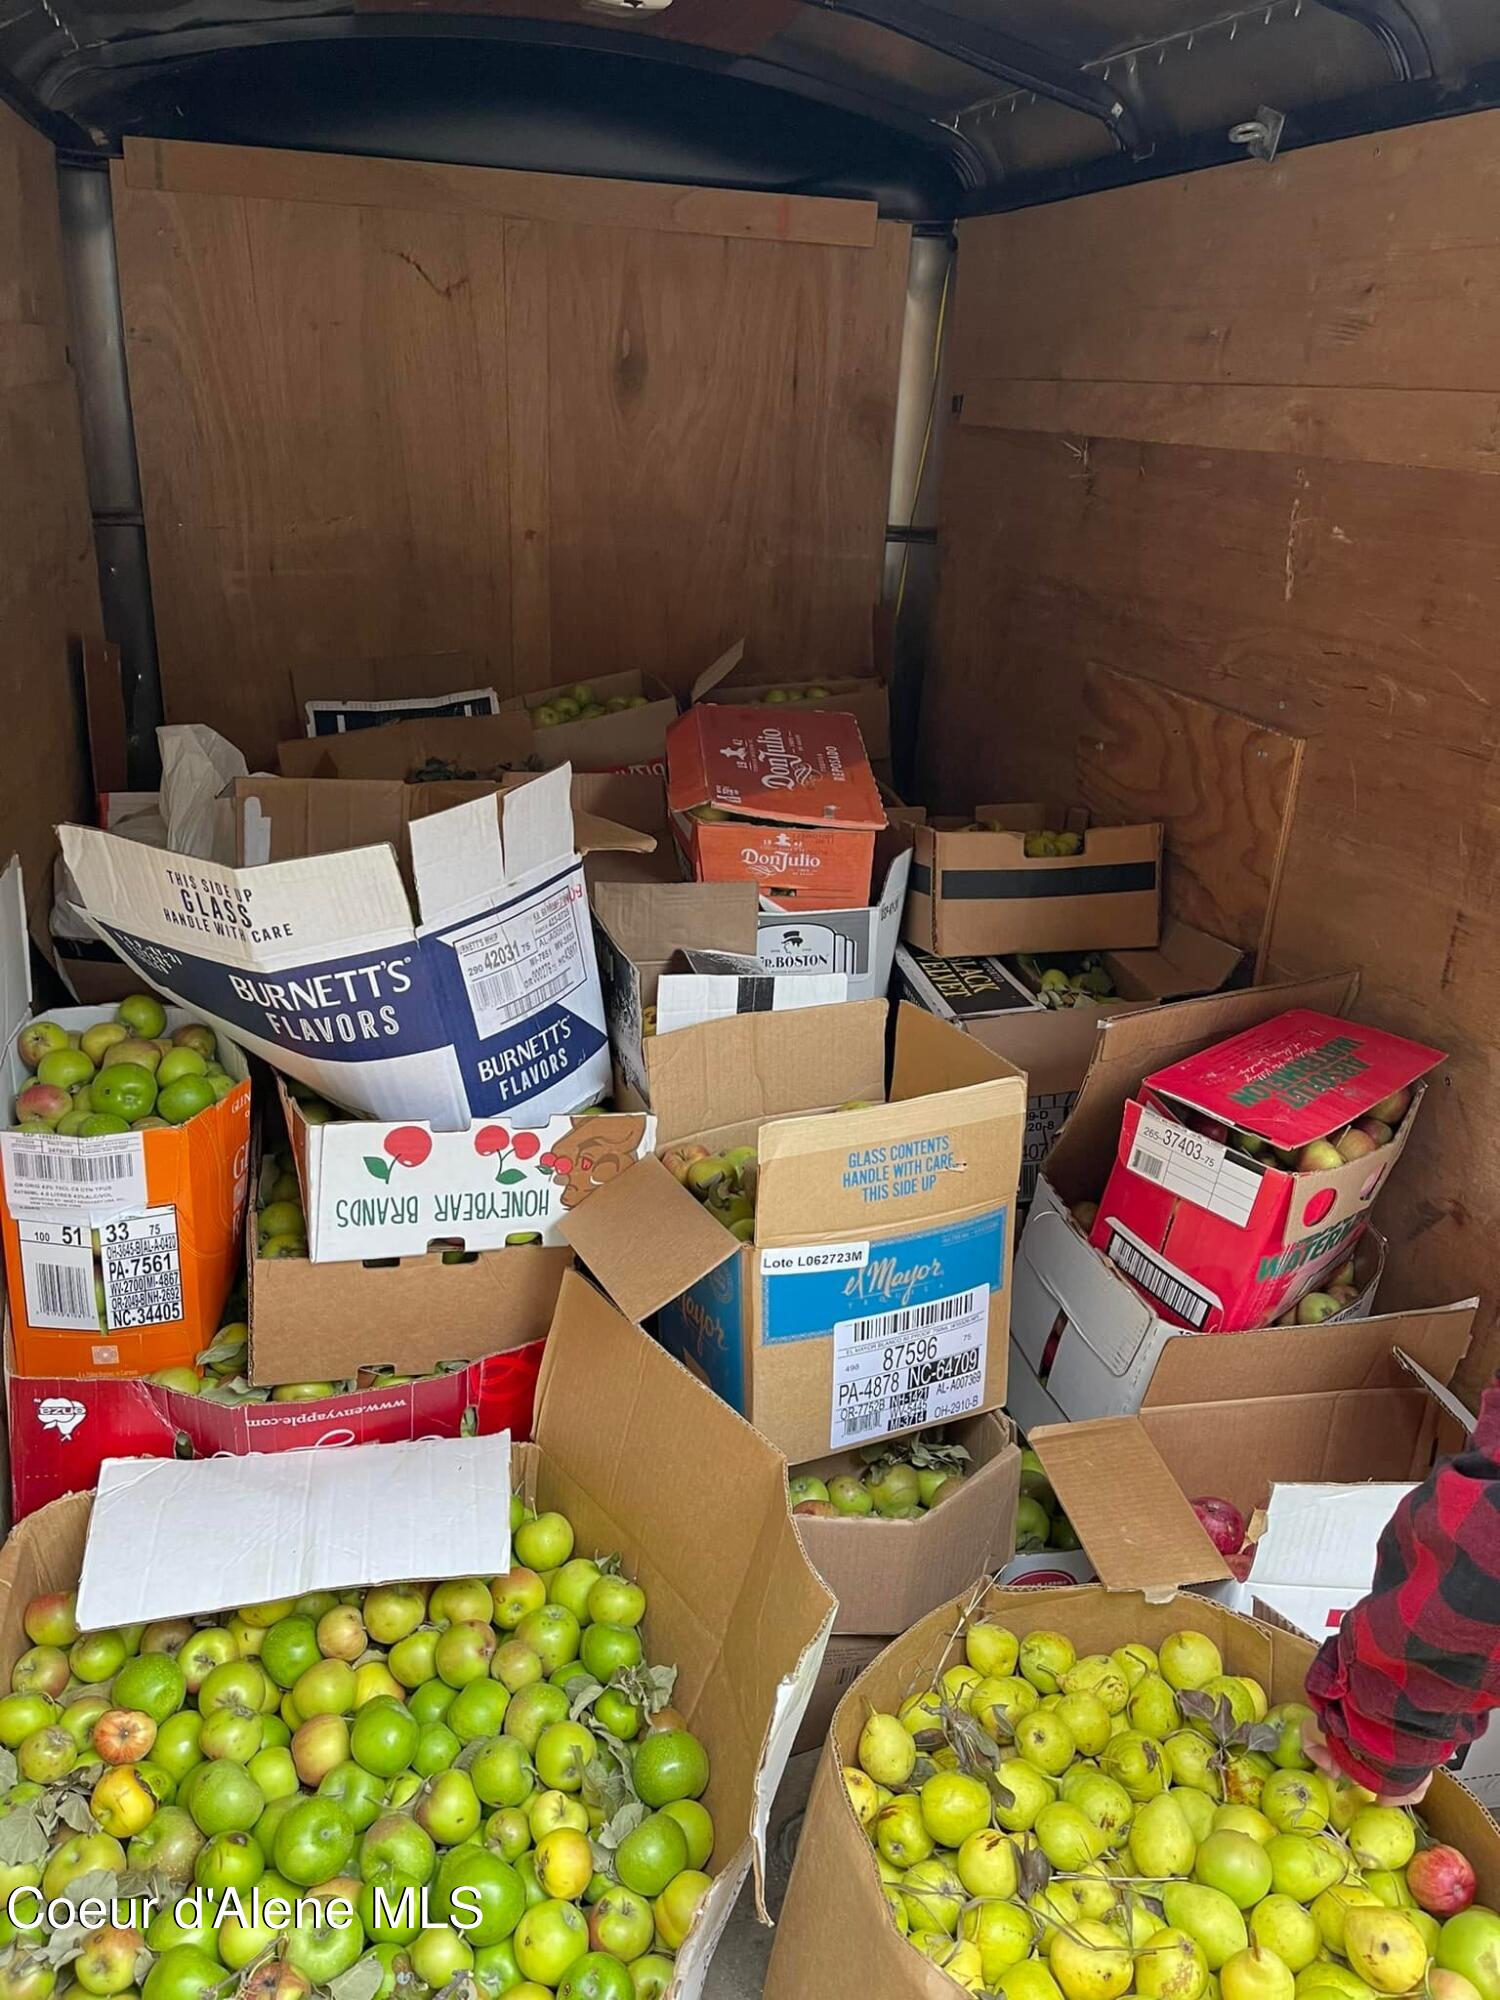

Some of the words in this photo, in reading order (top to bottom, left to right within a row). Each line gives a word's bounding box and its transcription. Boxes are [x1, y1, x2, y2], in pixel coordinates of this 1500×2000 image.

[166, 869, 197, 889] THIS
[201, 878, 231, 898] SIDE
[234, 888, 253, 902] UP
[163, 908, 210, 933] HANDLE
[214, 924, 246, 942] WITH
[251, 923, 294, 943] CARE
[181, 889, 252, 928] GLASS
[468, 964, 483, 976] 290
[484, 940, 520, 969] 42031
[228, 959, 411, 1011] BURNETT'S
[265, 1005, 400, 1043] FLAVORS
[478, 1017, 571, 1082] BURNETT'S
[499, 1047, 568, 1101] FLAVORS
[848, 1147, 887, 1168] GLASS
[890, 1135, 950, 1161] CONTENTS
[843, 1165, 889, 1188] HANDLE
[893, 1160, 922, 1179] WITH
[926, 1152, 954, 1171] CARE
[434, 1189, 549, 1222] HONEYBEAR
[862, 1184, 889, 1203] THIS
[892, 1178, 918, 1198] SIDE
[922, 1174, 937, 1192] UP
[335, 1195, 419, 1228] BRANDS
[34, 1232, 50, 1242] 100
[62, 1226, 82, 1246] 51
[106, 1222, 130, 1243] 33
[149, 1224, 161, 1235] 75
[109, 1253, 171, 1282] PA-7561
[763, 1257, 793, 1269] Lote
[797, 1251, 863, 1267] L062723M
[867, 1257, 942, 1305] Mayor
[113, 1303, 180, 1328] NC-34405
[883, 1336, 938, 1371] 87596
[839, 1371, 900, 1406] PA-4878
[909, 1348, 979, 1390] NC-64709
[244, 1399, 407, 1427] www.envyapple.com
